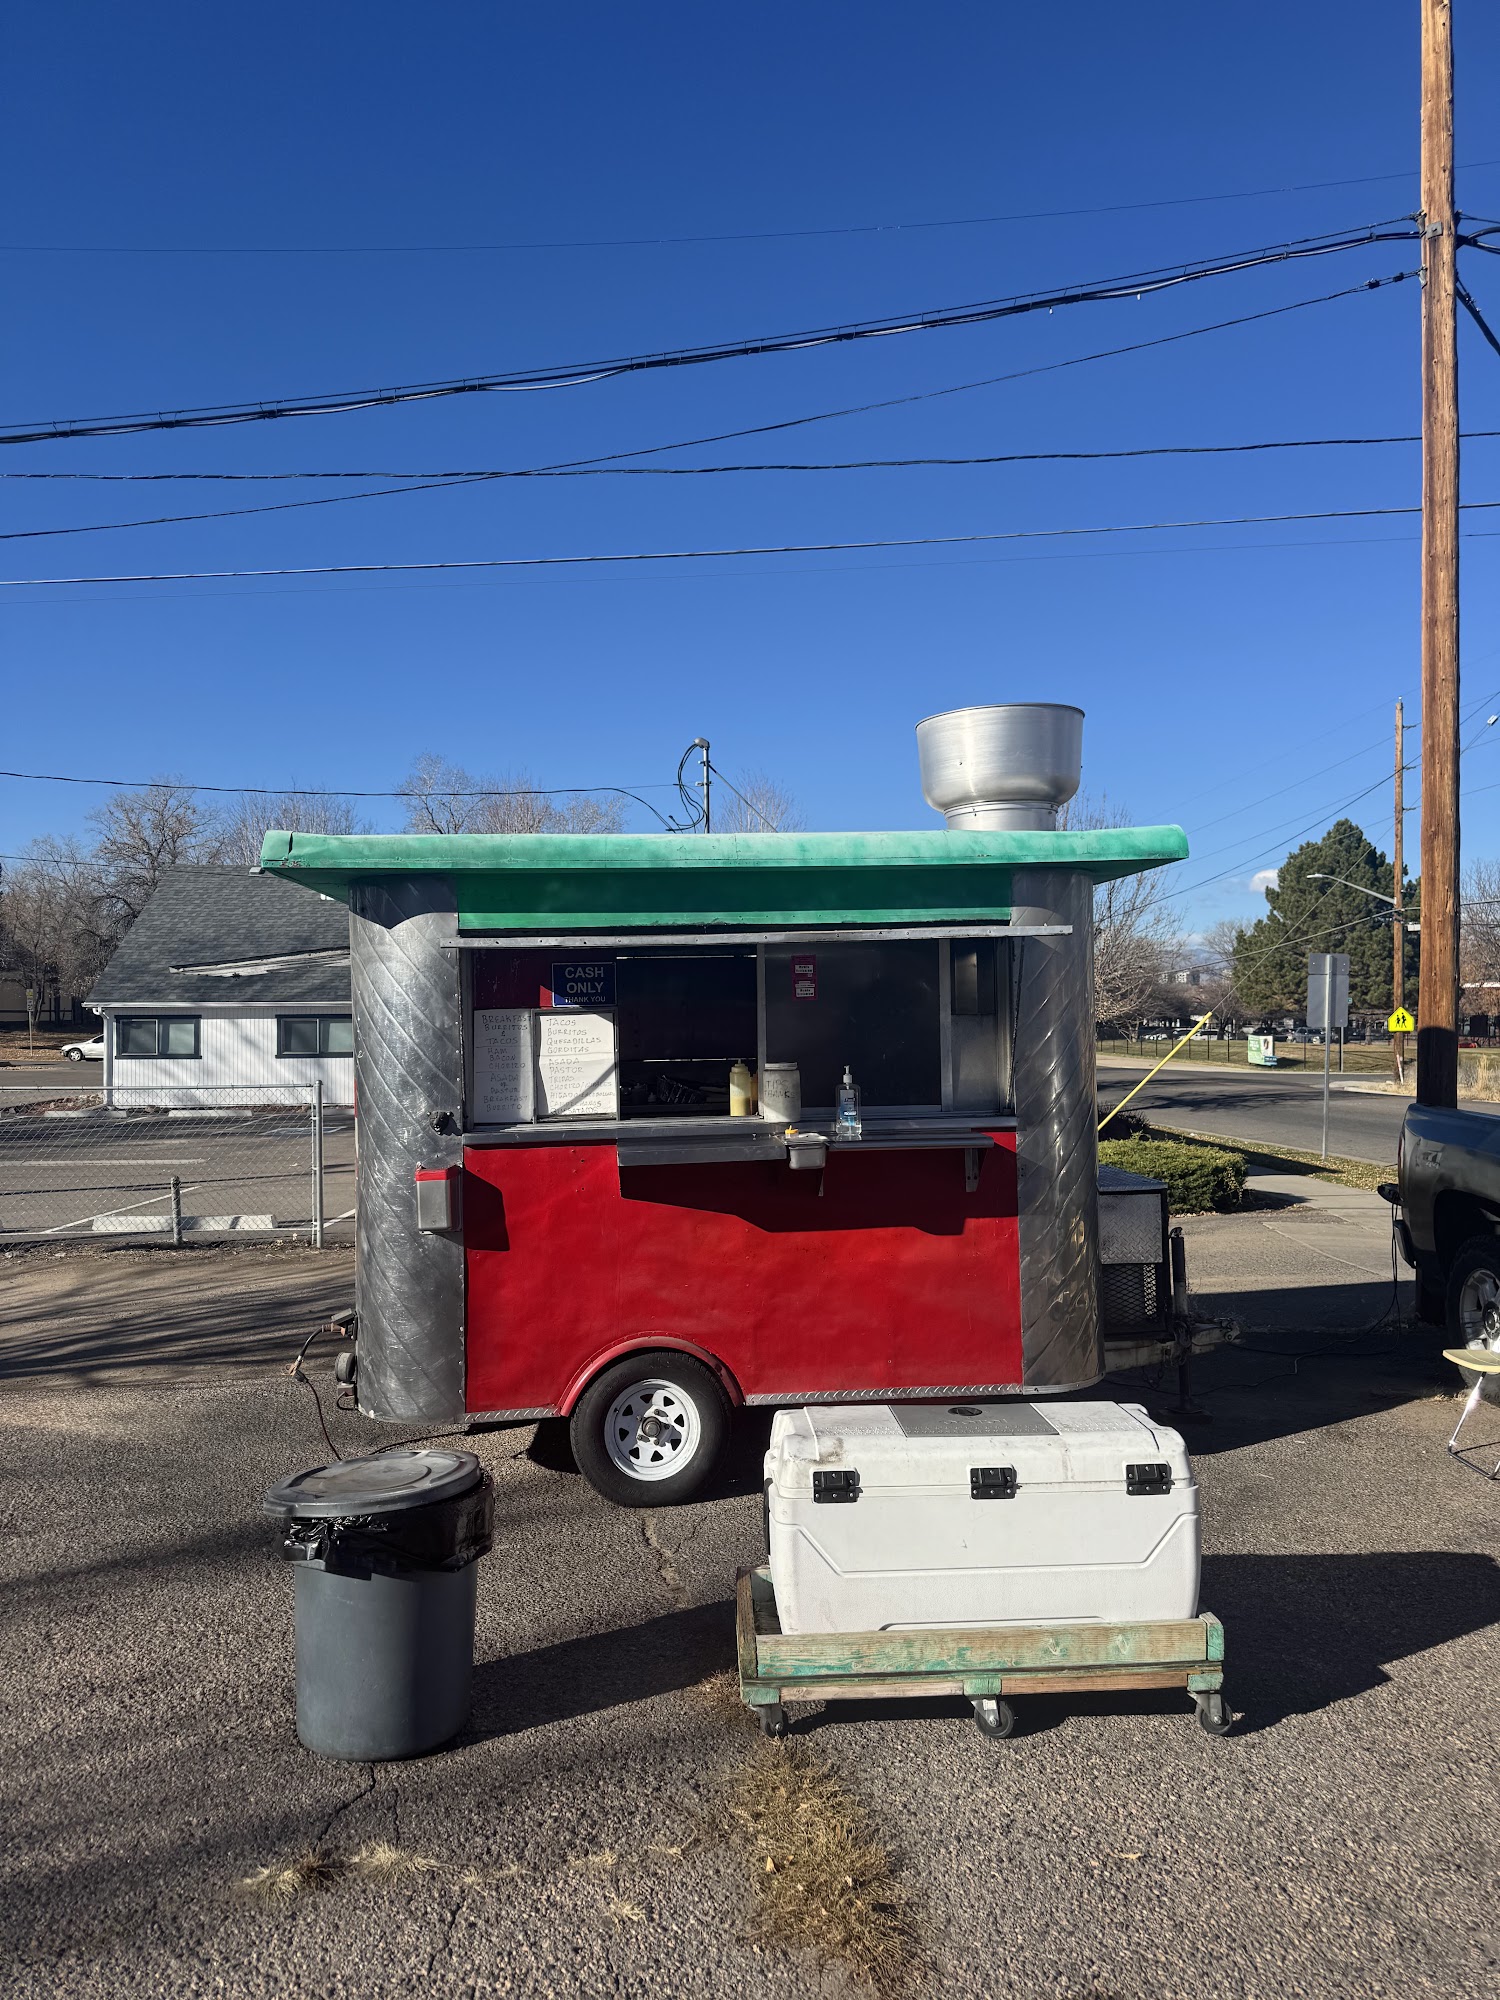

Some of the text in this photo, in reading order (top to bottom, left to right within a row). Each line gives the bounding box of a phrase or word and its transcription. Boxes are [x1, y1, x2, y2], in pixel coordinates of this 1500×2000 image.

[565, 966, 604, 978] CASH
[566, 981, 604, 993] ONLY
[482, 1014, 531, 1024] BREAKFAST
[546, 1018, 577, 1027] TACOS
[484, 1023, 528, 1031] BURRITOS
[547, 1028, 587, 1037] BURRITOS
[486, 1037, 518, 1045] TACOS
[546, 1037, 602, 1046] QUESADILLAS
[487, 1047, 507, 1055] HAM
[547, 1046, 590, 1054] GORDITAS
[488, 1062, 526, 1070] CHORIZO
[548, 1057, 580, 1066] ASADA
[549, 1066, 584, 1075] PASTOR
[490, 1073, 519, 1082] ASADA
[765, 1079, 790, 1090] TIPS
[490, 1087, 520, 1095] PASTOR
[483, 1095, 528, 1104] BREAKFAST
[486, 1104, 523, 1112] BURRITO
